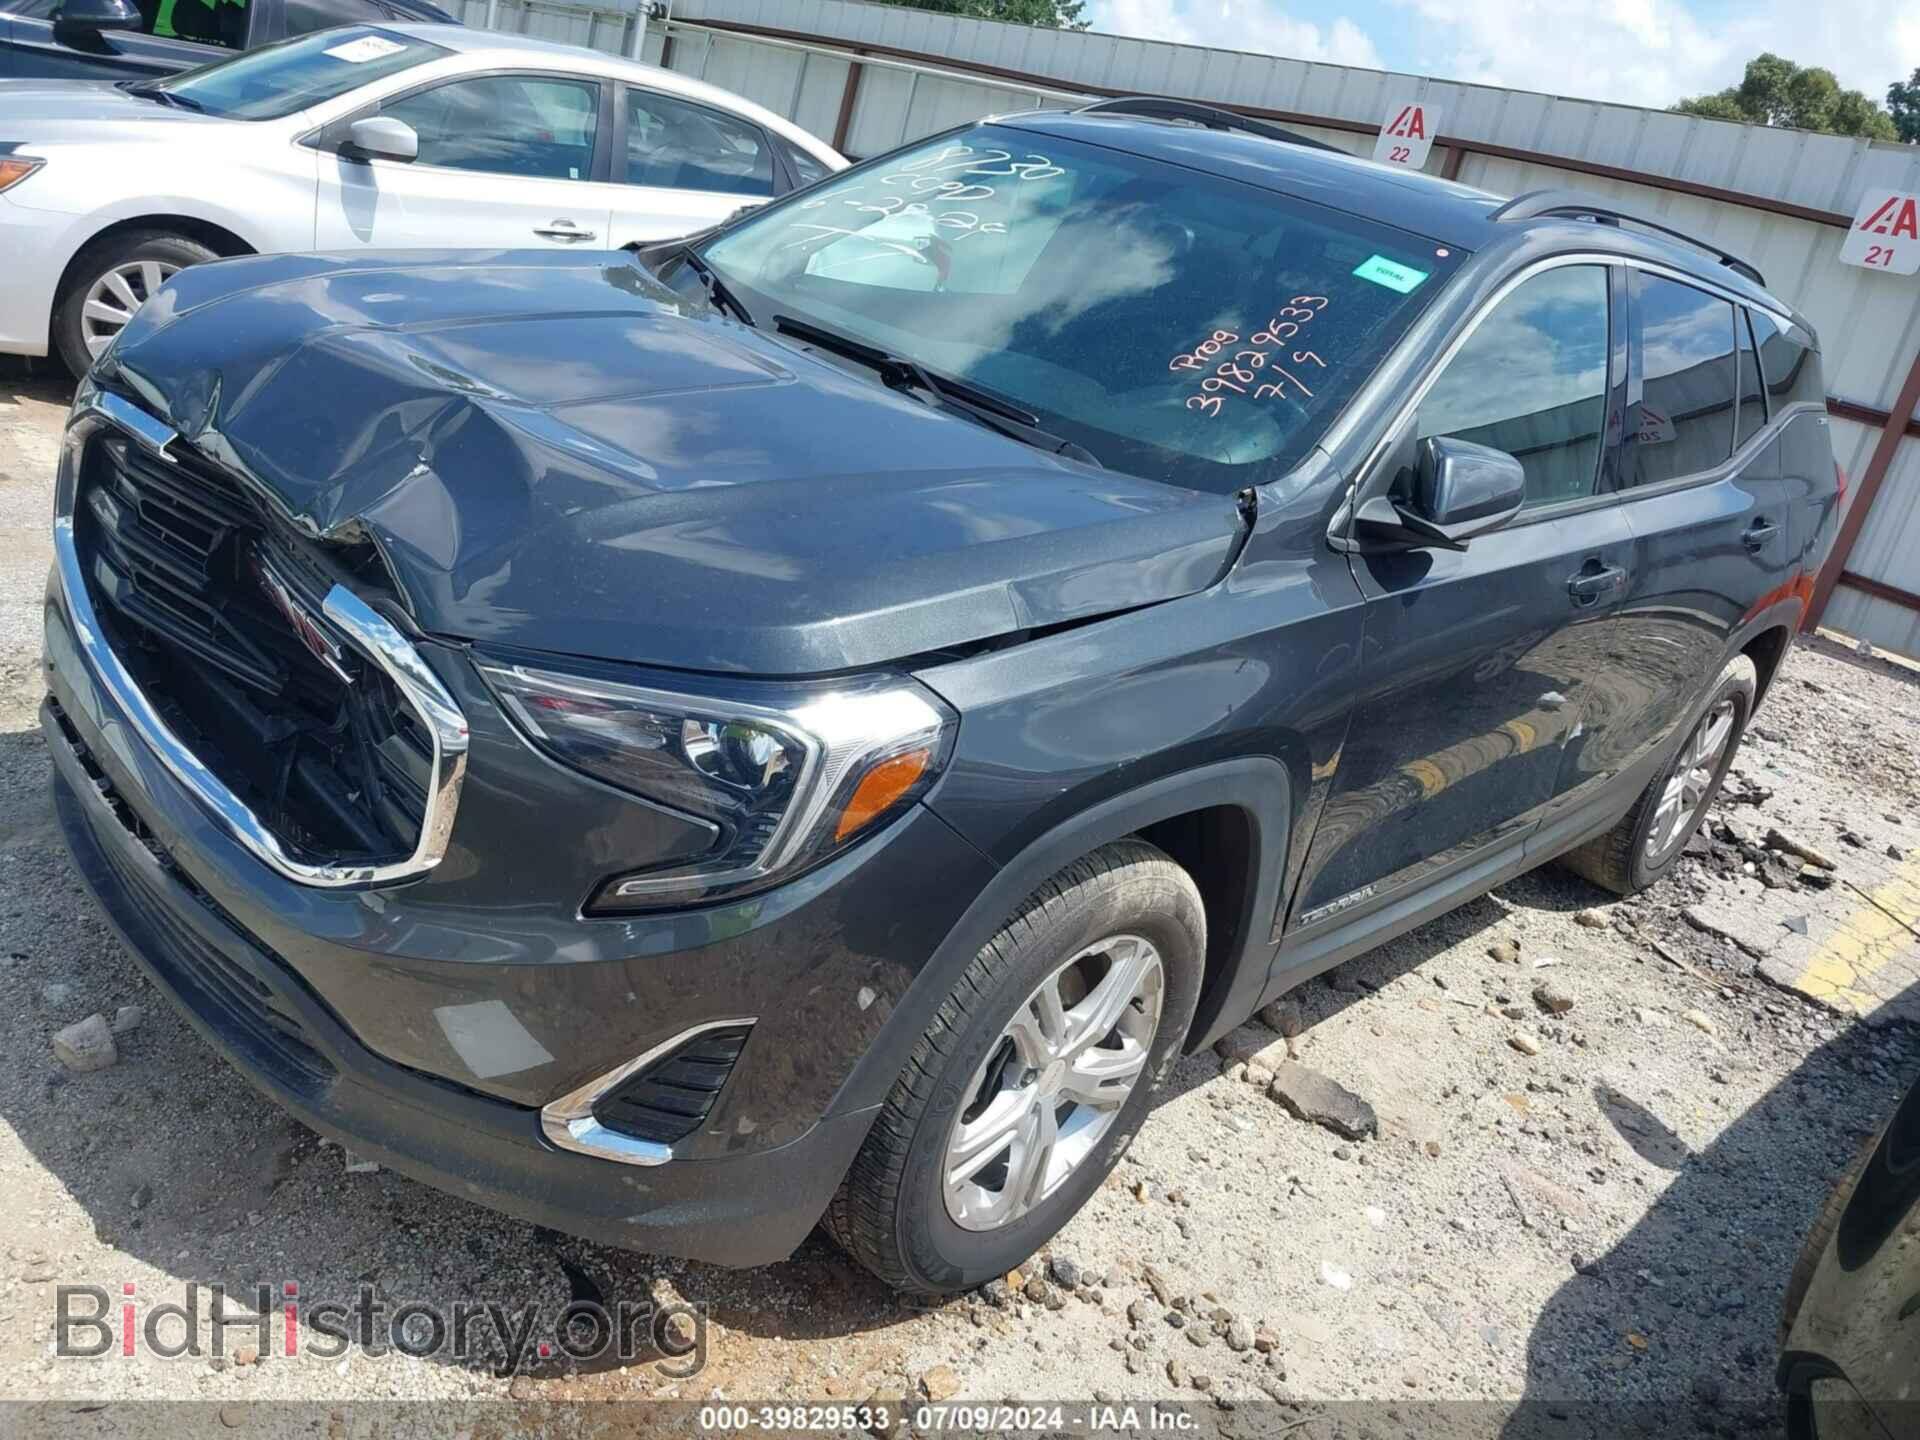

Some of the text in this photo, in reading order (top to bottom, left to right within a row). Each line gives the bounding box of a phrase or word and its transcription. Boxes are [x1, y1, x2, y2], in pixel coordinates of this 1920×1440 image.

[1389, 146, 1410, 163] 22
[1864, 246, 1895, 267] 21
[1186, 296, 1329, 418] 39829533
